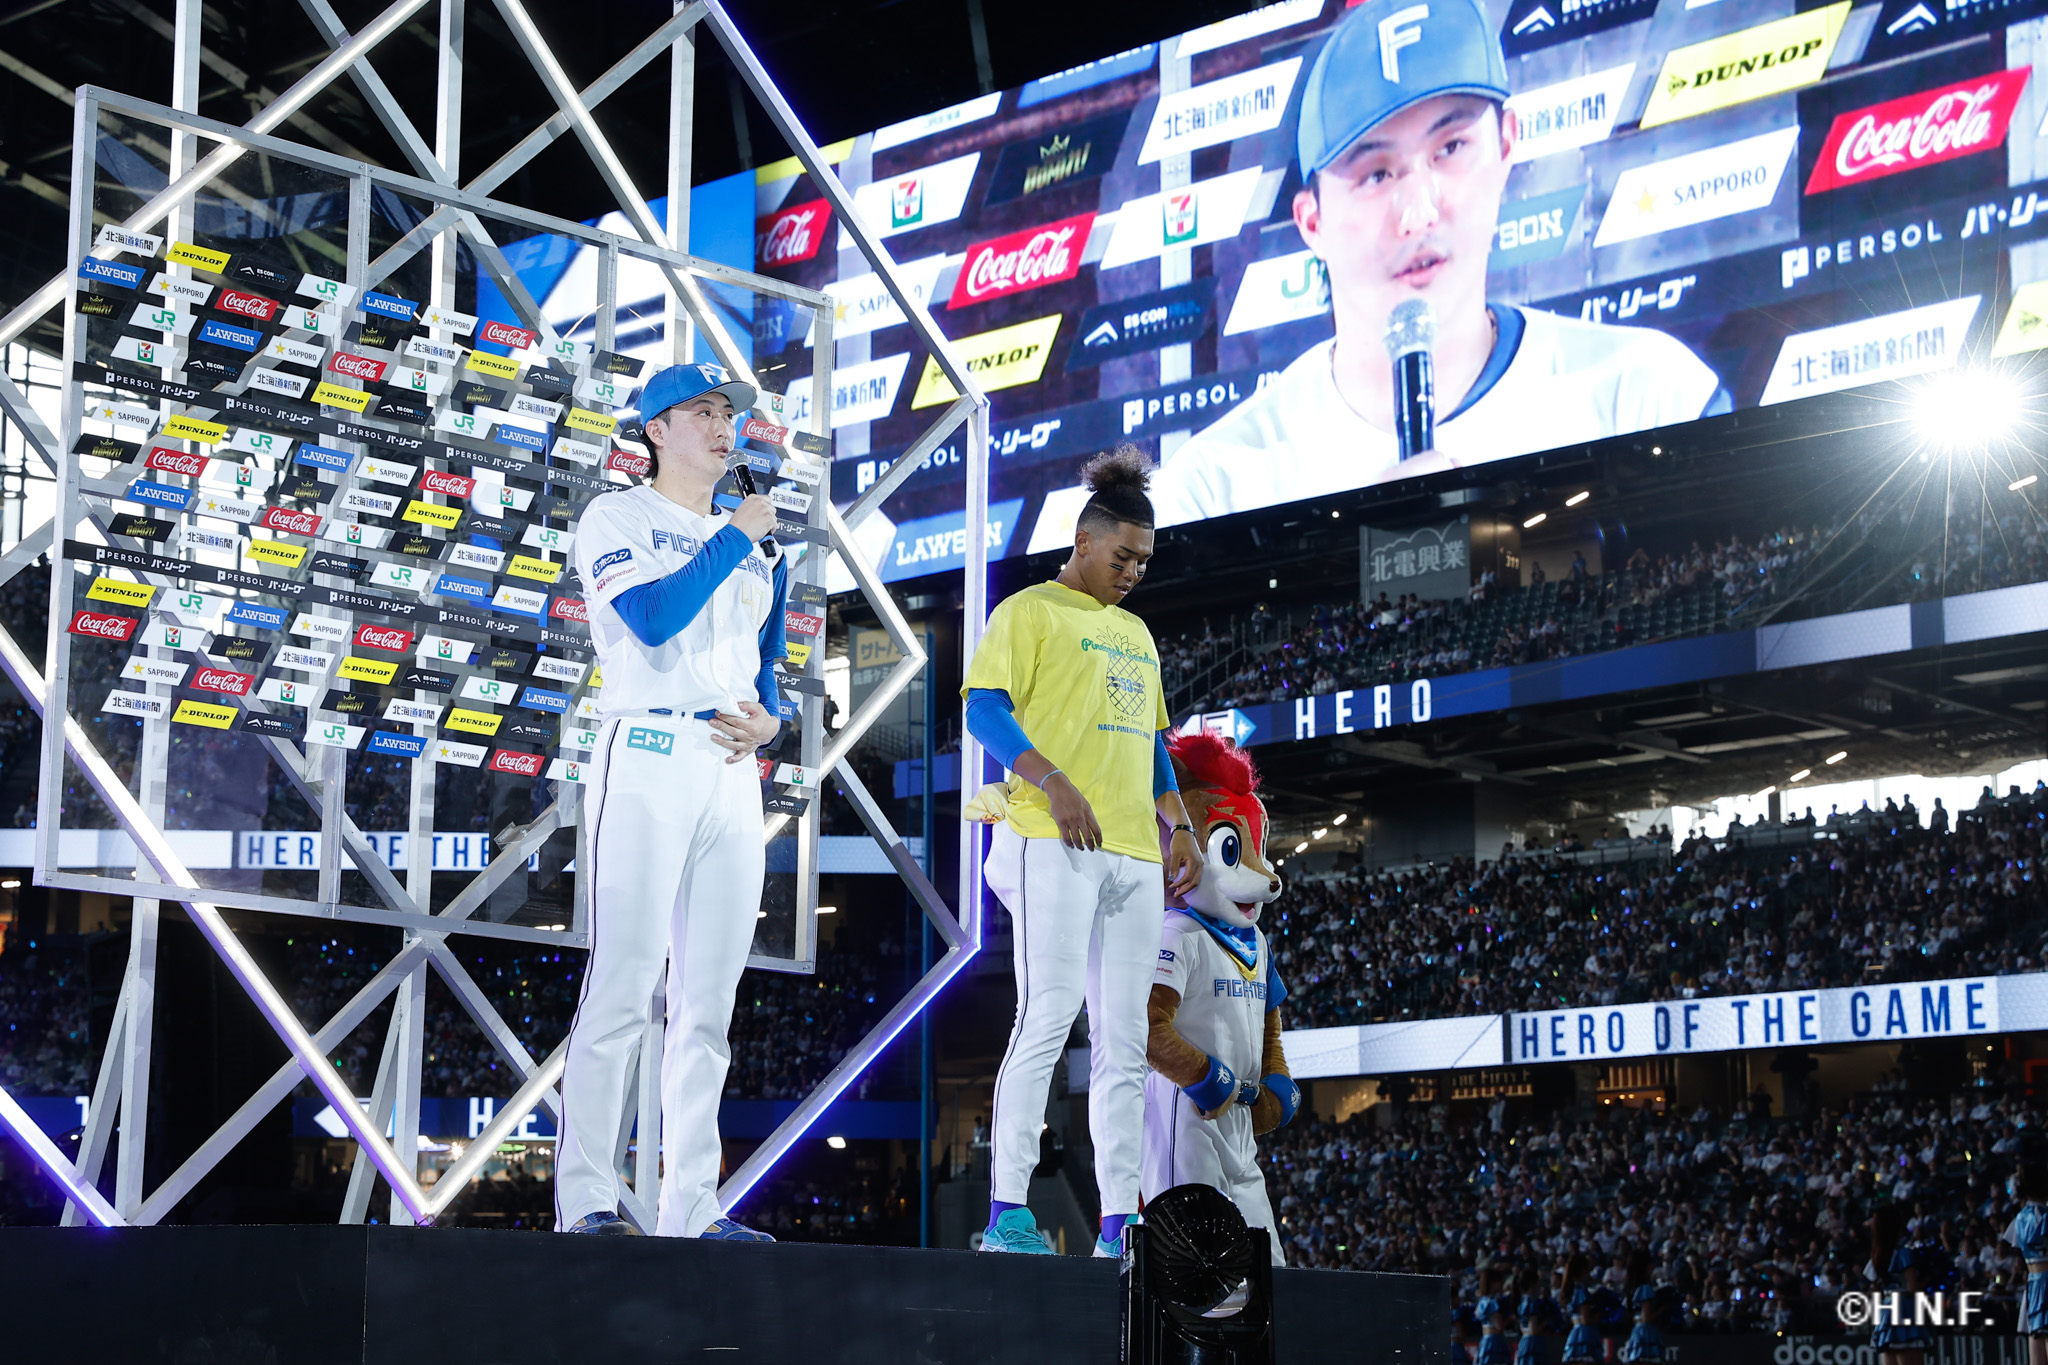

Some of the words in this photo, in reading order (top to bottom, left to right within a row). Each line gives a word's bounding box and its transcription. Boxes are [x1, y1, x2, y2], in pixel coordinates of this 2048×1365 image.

[1692, 38, 1822, 88] DUNLOP
[1835, 82, 2000, 177] Coca-Cola
[1673, 165, 1766, 206] SAPPORO
[1815, 219, 1942, 269] PERSOL
[181, 251, 223, 266] DUNLOP
[966, 226, 1076, 296] Coca-Cola
[85, 262, 137, 282] LAWSON
[173, 285, 204, 299] SAPPORO
[316, 280, 338, 297] JR
[223, 292, 271, 318] Coca-Cola
[366, 297, 411, 316] LAWSON
[152, 310, 176, 327] JR
[443, 318, 470, 330] SAPPORO
[207, 326, 254, 346] LAWSON
[487, 324, 529, 347] Coca-Cola
[288, 348, 317, 361] SAPPORO
[555, 341, 574, 356] JR
[335, 355, 378, 379] Coca-Cola
[479, 360, 515, 372] DUNLOP
[966, 345, 1039, 374] UNLOP
[116, 375, 155, 390] PERSOL
[160, 384, 200, 399] パ・リーグ
[596, 384, 614, 399] JR
[326, 391, 364, 404] DUNLOP
[1148, 382, 1241, 420] PERSOL
[118, 412, 150, 425] SAPPORO
[236, 401, 272, 416] PERSOL
[277, 410, 314, 425] パ・リーグ
[178, 424, 219, 438] DUNLOP
[454, 416, 474, 430] JR
[578, 416, 612, 429] DUNLOP
[347, 426, 382, 440] PERSOL
[386, 435, 422, 448] パ・リーグ
[501, 430, 543, 448] LAWSON
[747, 421, 782, 442] Coca-Cola
[250, 434, 272, 450] JR
[152, 450, 202, 475] Coca-Cola
[302, 449, 347, 467] LAWSON
[456, 450, 488, 462] PERSOL
[492, 457, 526, 471] パ・リーグ
[572, 448, 597, 460] SAPPORO
[379, 468, 408, 480] SAPPORO
[556, 472, 587, 485] PERSOL
[590, 480, 622, 493] パ・リーグ
[796, 470, 818, 480] SAPPORO
[426, 472, 469, 496] Coca-Cola
[135, 486, 185, 504] LAWSON
[220, 505, 250, 517] SAPPORO
[417, 510, 455, 522] DUNLOP
[268, 509, 314, 533] Coca-Cola
[539, 530, 558, 545] JR
[896, 521, 1003, 565] LAWSN
[259, 547, 299, 560] DUNLOP
[1371, 540, 1465, 582] 北電興業
[107, 552, 146, 564] PERSOL
[151, 558, 191, 573] パ・リーグ
[520, 564, 555, 576] DUNLOP
[390, 567, 412, 582] JR
[605, 566, 636, 583] Nipponham
[227, 573, 264, 586] PERSOL
[268, 580, 306, 594] パ・リーグ
[440, 580, 483, 596] LAWSON
[104, 587, 147, 598] DUNLOP
[179, 594, 203, 610] JR
[339, 594, 374, 607] PERSOL
[379, 600, 416, 614] パ・リーグ
[514, 596, 540, 608] SAPPORO
[233, 608, 281, 625] LAWSON
[448, 613, 482, 626] PERSOL
[486, 620, 519, 633] パ・リーグ
[77, 614, 128, 638] Coca-Cola
[314, 624, 342, 636] SAPPORO
[360, 627, 406, 650] Coca-Cola
[549, 634, 580, 645] PERSOL
[787, 649, 806, 658] NLOP
[147, 667, 179, 679] SAPPORO
[351, 666, 391, 676] DUNLOP
[198, 670, 246, 693] Coca-Cola
[480, 682, 500, 696] JR
[1120, 677, 1133, 693] 53
[526, 693, 567, 708] LAWSON
[1295, 678, 1432, 740] HERO
[188, 710, 230, 720] DUNLOP
[459, 717, 496, 727] DUNLOP
[324, 726, 346, 740] JR
[1116, 725, 1143, 738] PINEAPPLE
[375, 737, 420, 751] LAWSON
[631, 730, 671, 751] ニトリ
[452, 750, 479, 761] SAPPORO
[496, 752, 538, 773] Coca-Cola
[248, 836, 313, 866] HER
[1520, 1011, 1624, 1059] HERO
[1655, 1003, 1700, 1050] OF
[1731, 995, 1818, 1045] THE
[1852, 982, 1986, 1038] GAME
